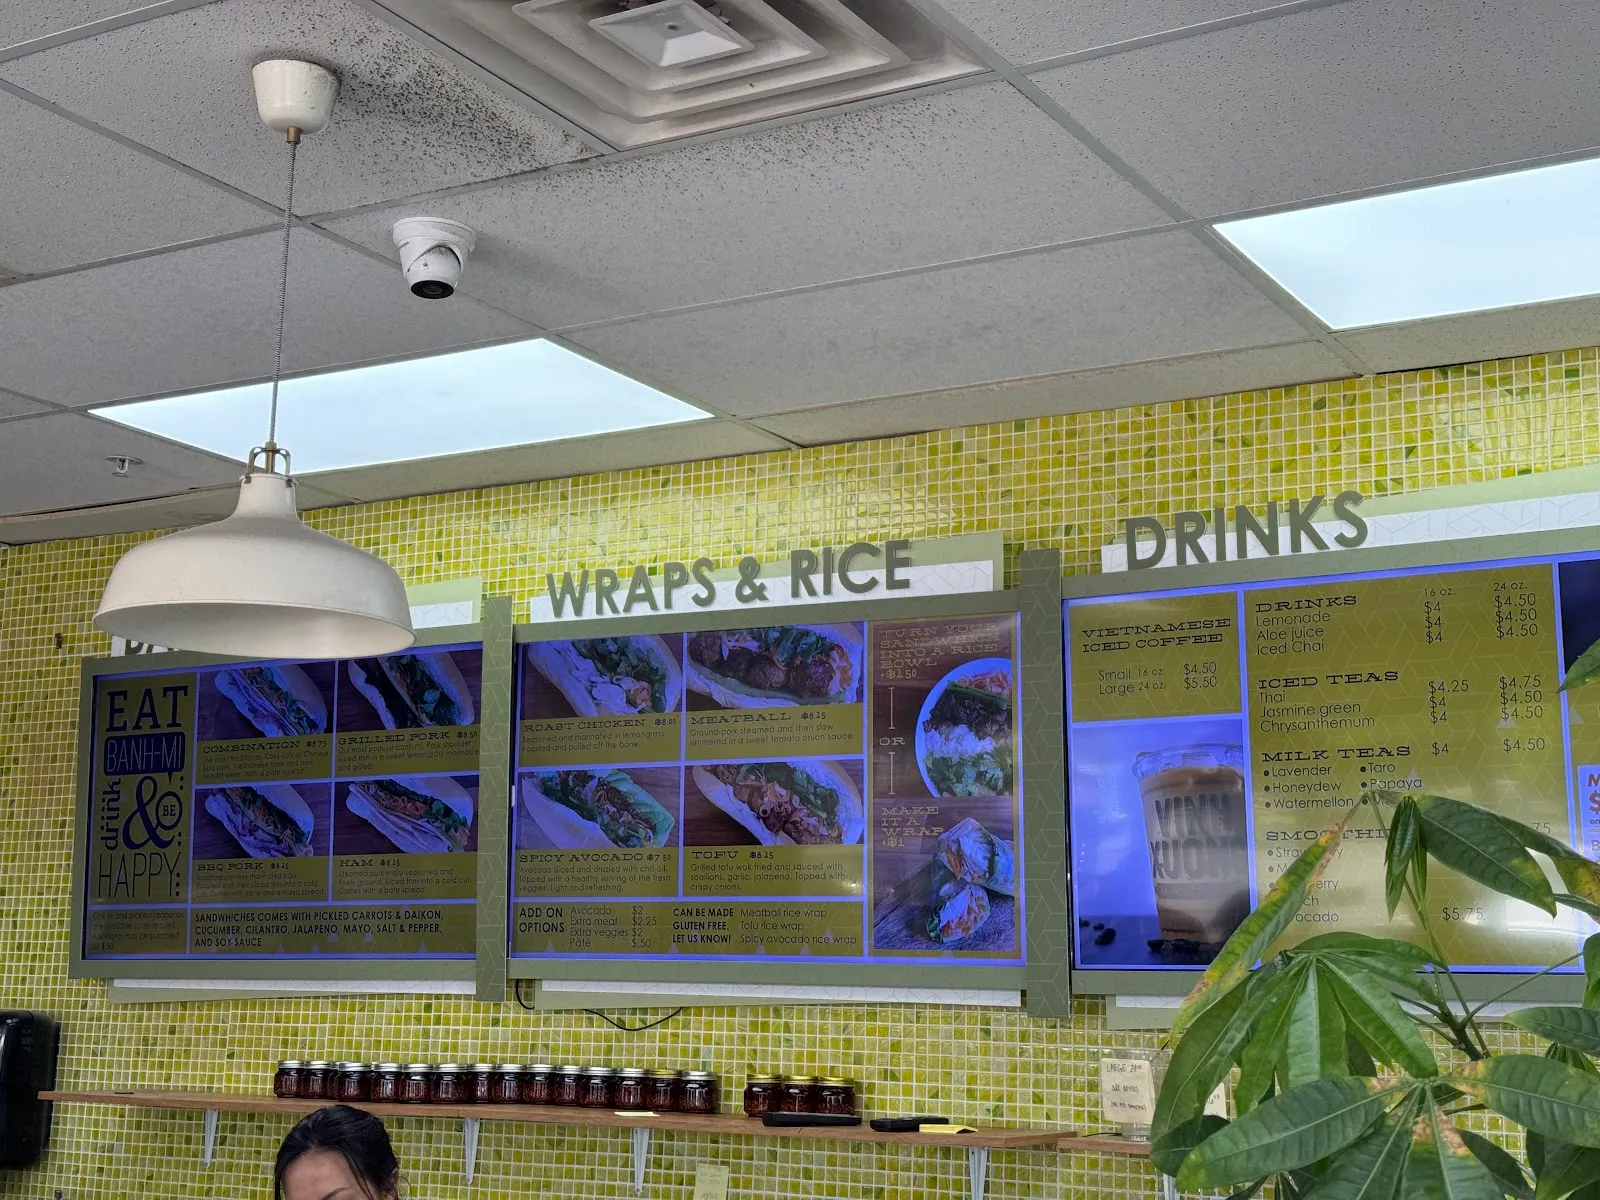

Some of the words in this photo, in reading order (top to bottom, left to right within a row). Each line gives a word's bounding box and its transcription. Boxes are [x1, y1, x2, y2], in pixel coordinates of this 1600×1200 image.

[1125, 490, 1368, 570] DRINKS
[546, 557, 716, 618] WRAPS
[735, 556, 770, 603] &
[791, 539, 912, 598] RICE
[1424, 588, 1436, 597] 16
[1439, 588, 1457, 596] oz.
[1493, 582, 1506, 592] 24
[1510, 582, 1527, 590] oz.
[1255, 595, 1357, 613] DRINKS
[1424, 600, 1441, 613] $4
[1495, 593, 1536, 609] $4.50
[1256, 611, 1331, 628] Lemonade
[1425, 615, 1442, 628] $4
[1496, 608, 1537, 624] $4.50
[880, 627, 938, 638] TURN
[943, 622, 1000, 634] YOUR
[1082, 618, 1231, 638] VIETNAMESE
[1256, 630, 1287, 642] Aloe
[1291, 626, 1324, 641] juice
[1426, 630, 1443, 645] $4
[1496, 623, 1538, 640] $4.50
[1082, 640, 1131, 653] ICED
[1135, 633, 1223, 648] COFFEE
[1257, 642, 1287, 656] Iced
[1291, 639, 1325, 653] Chai
[880, 648, 926, 660] INTO
[930, 647, 945, 656] A
[950, 643, 998, 655] RICE
[880, 658, 938, 669] BOWL
[1098, 667, 1131, 682] Small
[1138, 668, 1148, 678] 16
[1183, 661, 1217, 676] $4.50
[1099, 682, 1134, 697] Large
[1138, 682, 1149, 692] 24
[1183, 675, 1217, 691] $5.50
[1258, 676, 1318, 689] ICED
[1325, 670, 1399, 685] TEAS
[1259, 690, 1286, 703] Thai
[1428, 680, 1469, 695] $4.25
[1500, 675, 1541, 691] $4.75
[106, 685, 188, 732] EAT
[1260, 703, 1315, 718] Jasmine
[1319, 703, 1361, 717] green
[1429, 695, 1446, 710] $4
[1500, 690, 1543, 706] $4.50
[524, 722, 574, 732] ROAST
[577, 718, 647, 730] CHICKEN
[690, 712, 792, 724] MEATBALL
[1260, 716, 1376, 734] Chrysanthemum
[1430, 710, 1447, 725] $4
[1501, 705, 1543, 722] $4.50
[338, 733, 405, 747] GRILLED
[409, 730, 451, 742] PORK
[879, 736, 906, 747] OR
[107, 736, 182, 772] BANH-MI
[203, 740, 301, 754] COMBINATION
[1261, 749, 1330, 763] MILK
[1337, 745, 1411, 759] TEAS
[1432, 741, 1449, 757] $4
[1502, 737, 1546, 754] $4.50
[1272, 764, 1332, 777] Lavender
[1368, 762, 1396, 774] Taro
[1272, 780, 1342, 796] Honeydew
[1369, 777, 1422, 792] Papaya
[1273, 796, 1354, 809] Watermellon
[100, 777, 121, 851] drink
[122, 775, 175, 850] &
[162, 804, 176, 817] BE
[881, 806, 939, 816] MAKE
[881, 817, 902, 826] IT
[906, 817, 920, 826] A
[881, 827, 944, 837] WRAP
[520, 854, 564, 863] SPICY
[568, 852, 643, 862] AVOCADO
[691, 850, 740, 859] TOFU
[197, 863, 224, 872] BBQ
[228, 862, 264, 871] PORK
[339, 859, 373, 868] HAM
[690, 863, 715, 872] Grilled
[718, 862, 733, 872] tofu
[735, 863, 752, 871] wok
[754, 862, 772, 871] fried
[774, 862, 791, 871] and
[792, 861, 823, 871] sauced
[825, 861, 843, 870] with
[98, 852, 182, 898] HAPPY
[195, 911, 255, 922] SANDWHICHES
[257, 911, 288, 922] COMES
[291, 910, 312, 921] WITH
[314, 909, 349, 921] PICKLED
[352, 909, 393, 920] CARROTS
[395, 909, 401, 919] &
[404, 908, 444, 921] DAIKON,
[519, 907, 542, 918] ADD
[546, 907, 563, 918] ON
[570, 905, 612, 916] Avocado
[631, 905, 643, 916] $2
[672, 908, 693, 918] CAN
[695, 908, 706, 917] BE
[708, 908, 734, 917] MADE
[740, 908, 781, 918] Meatball
[783, 908, 801, 917] rice
[803, 909, 827, 920] wrap
[195, 924, 243, 935] CUCUMBER,
[245, 924, 290, 935] CILANTRO,
[343, 923, 374, 934] MAYO,
[376, 922, 398, 933] SALT
[399, 922, 405, 932] &
[408, 921, 442, 933] PEPPER,
[518, 921, 565, 933] OPTIONS
[570, 916, 592, 926] Extra
[594, 917, 618, 926] meat
[631, 916, 657, 927] $2.25
[672, 921, 705, 931] GLUTEN
[740, 920, 760, 930] Tofu
[761, 920, 778, 930] rice
[780, 922, 804, 933] wrap
[570, 928, 592, 938] Extra
[594, 928, 629, 940] veggies
[631, 928, 643, 939] $2
[672, 934, 686, 944] LET
[687, 934, 699, 944] US
[700, 934, 732, 944] KNOW!
[740, 934, 764, 945] Spicy
[767, 934, 810, 944] avocado
[812, 934, 831, 944] rice
[833, 935, 857, 946] wrap
[195, 937, 213, 947] AND
[214, 936, 233, 947] SOY
[234, 936, 262, 947] SAUCE
[569, 938, 591, 949] Pâté
[631, 939, 652, 950] $.50
